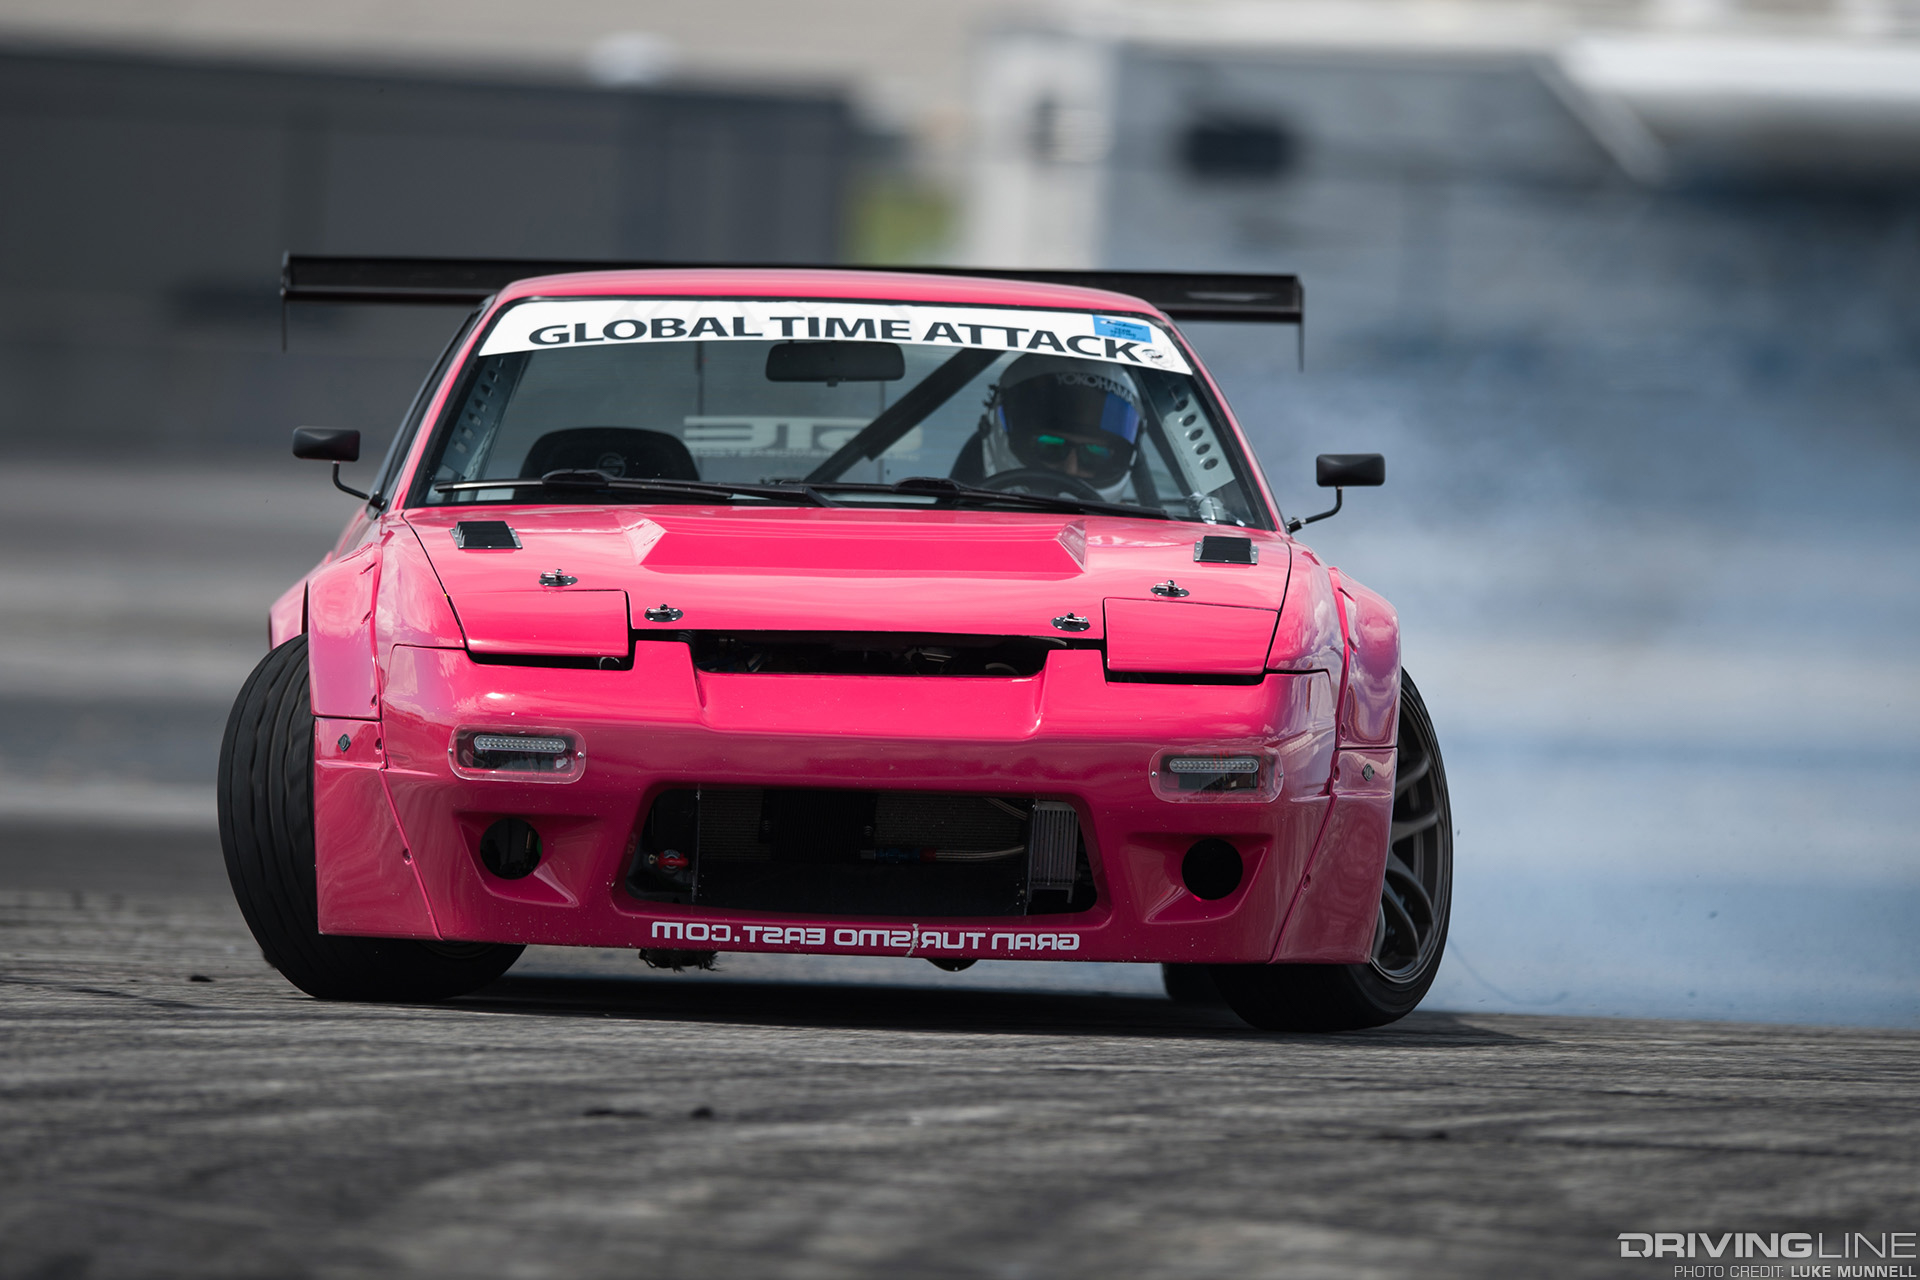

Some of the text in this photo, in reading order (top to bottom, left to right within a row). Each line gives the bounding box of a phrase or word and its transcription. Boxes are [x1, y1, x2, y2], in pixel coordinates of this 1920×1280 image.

[528, 316, 1142, 363] GLOBAL TIME ATTACK
